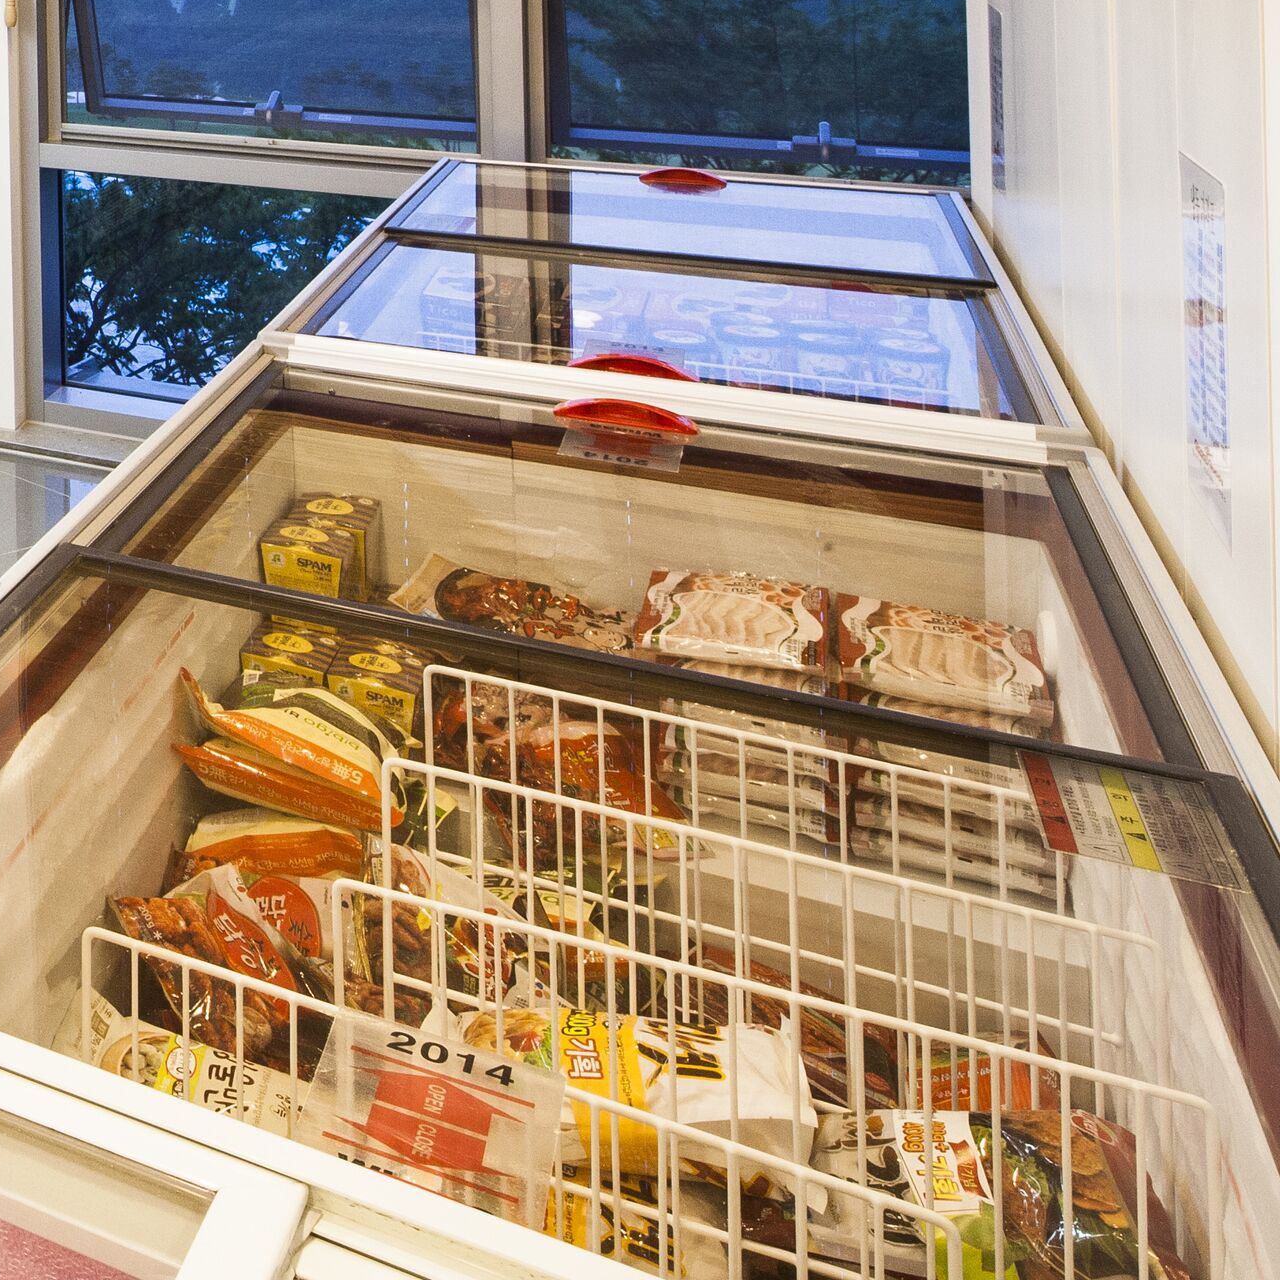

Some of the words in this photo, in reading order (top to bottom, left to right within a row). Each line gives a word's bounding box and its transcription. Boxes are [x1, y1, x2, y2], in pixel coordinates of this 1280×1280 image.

[296, 556, 333, 575] SPAM
[365, 689, 404, 708] SPAM
[303, 716, 361, 751] bibigo
[386, 1030, 516, 1087] 2014
[566, 1037, 605, 1081] 기획
[423, 1083, 448, 1114] OPEN
[411, 1123, 438, 1159] CLOSE
[901, 1121, 926, 1154] 400g
